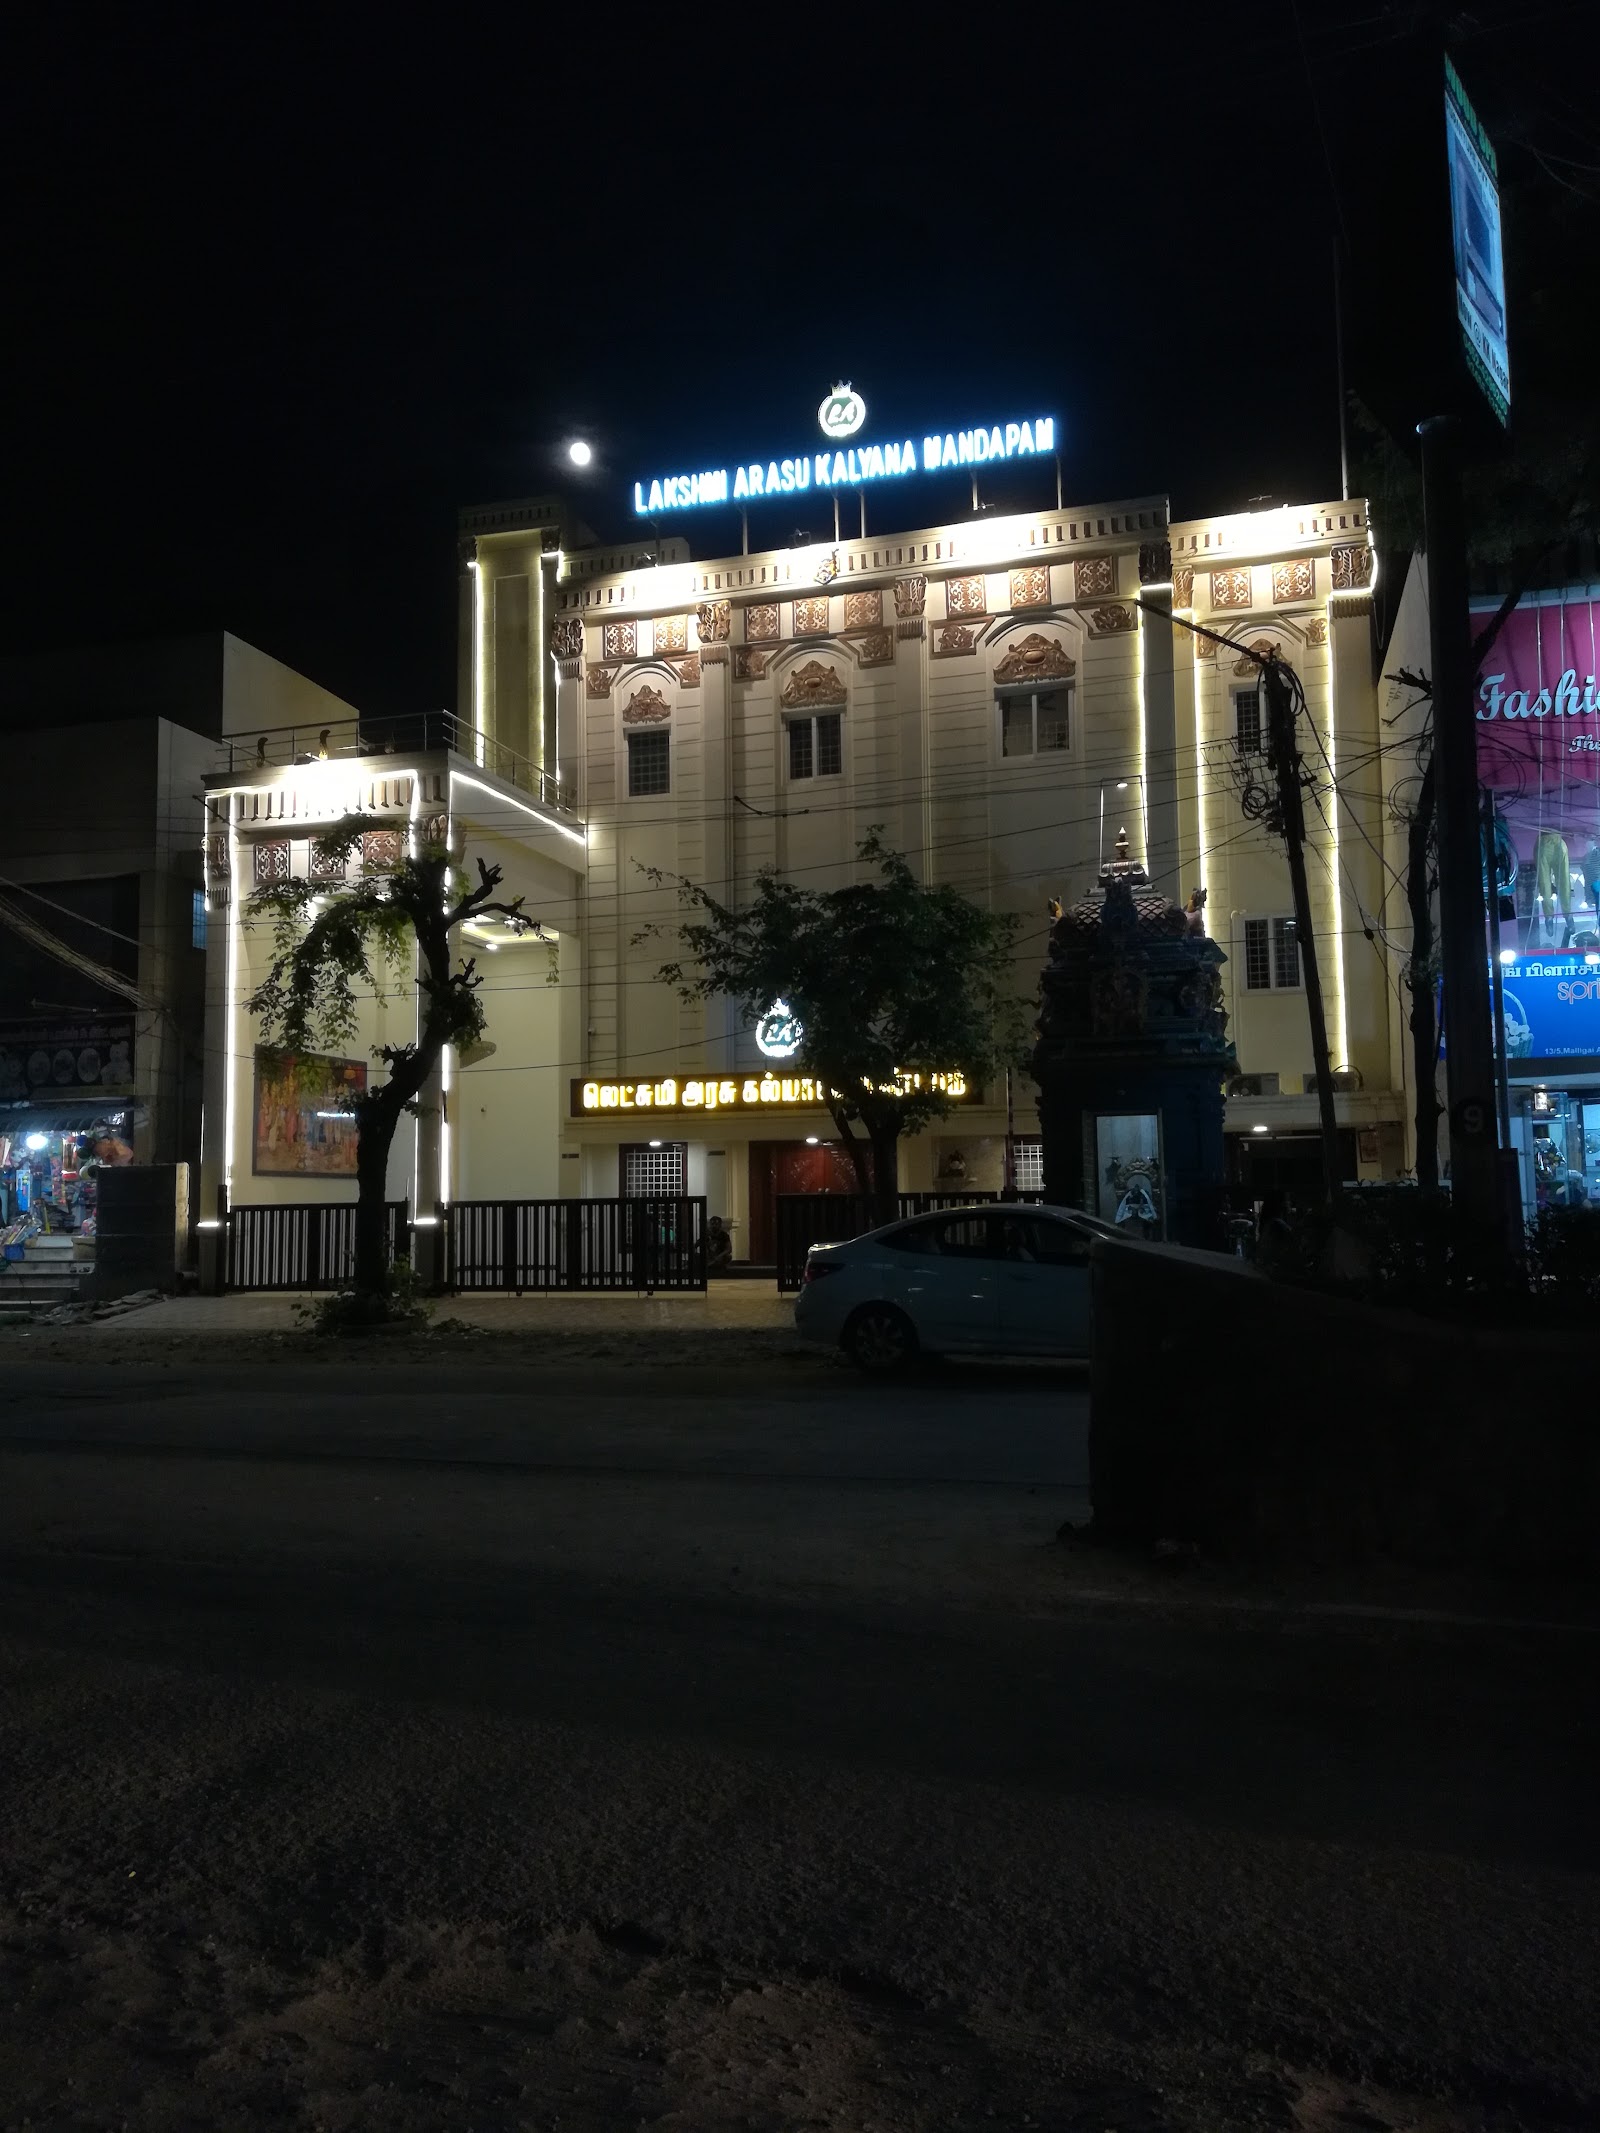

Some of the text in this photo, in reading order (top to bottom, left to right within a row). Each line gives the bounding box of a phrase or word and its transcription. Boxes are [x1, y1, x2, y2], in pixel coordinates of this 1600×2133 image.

[733, 457, 810, 499] ARASU
[815, 440, 916, 486] KALYANA
[923, 418, 1054, 470] MANDAPAM
[1476, 668, 1600, 720] Fashi
[681, 1081, 737, 1109] அரசு
